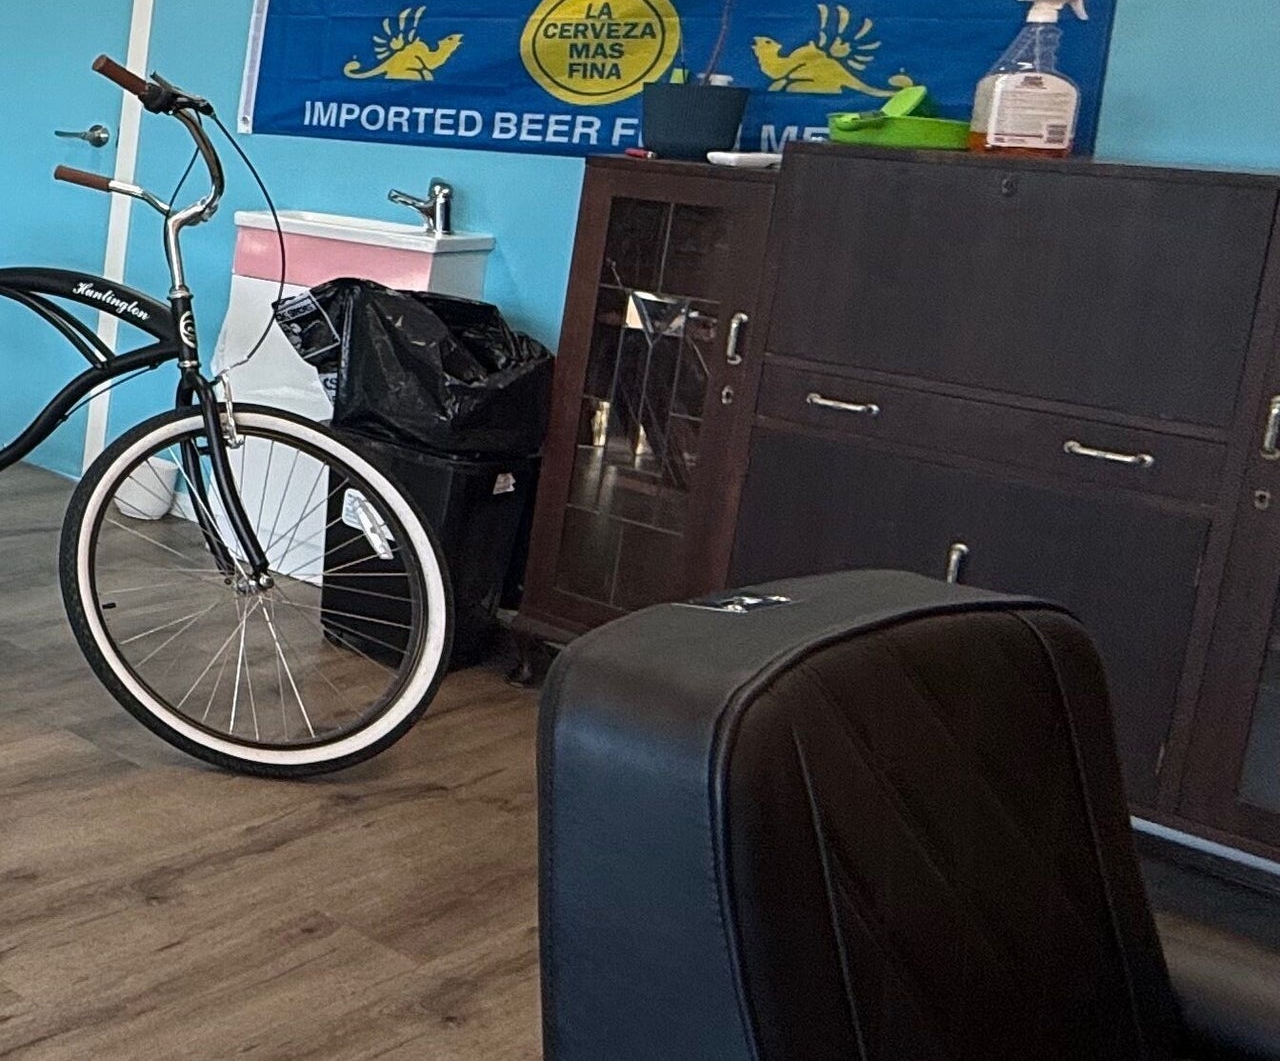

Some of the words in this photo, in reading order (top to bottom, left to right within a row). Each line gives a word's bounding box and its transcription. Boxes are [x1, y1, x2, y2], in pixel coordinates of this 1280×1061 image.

[585, 2, 612, 21] LA
[542, 23, 657, 40] CERVEZA
[568, 42, 625, 60] MAS
[567, 63, 622, 80] FINA
[302, 100, 484, 138] IMPORTED
[492, 111, 602, 146] BEER
